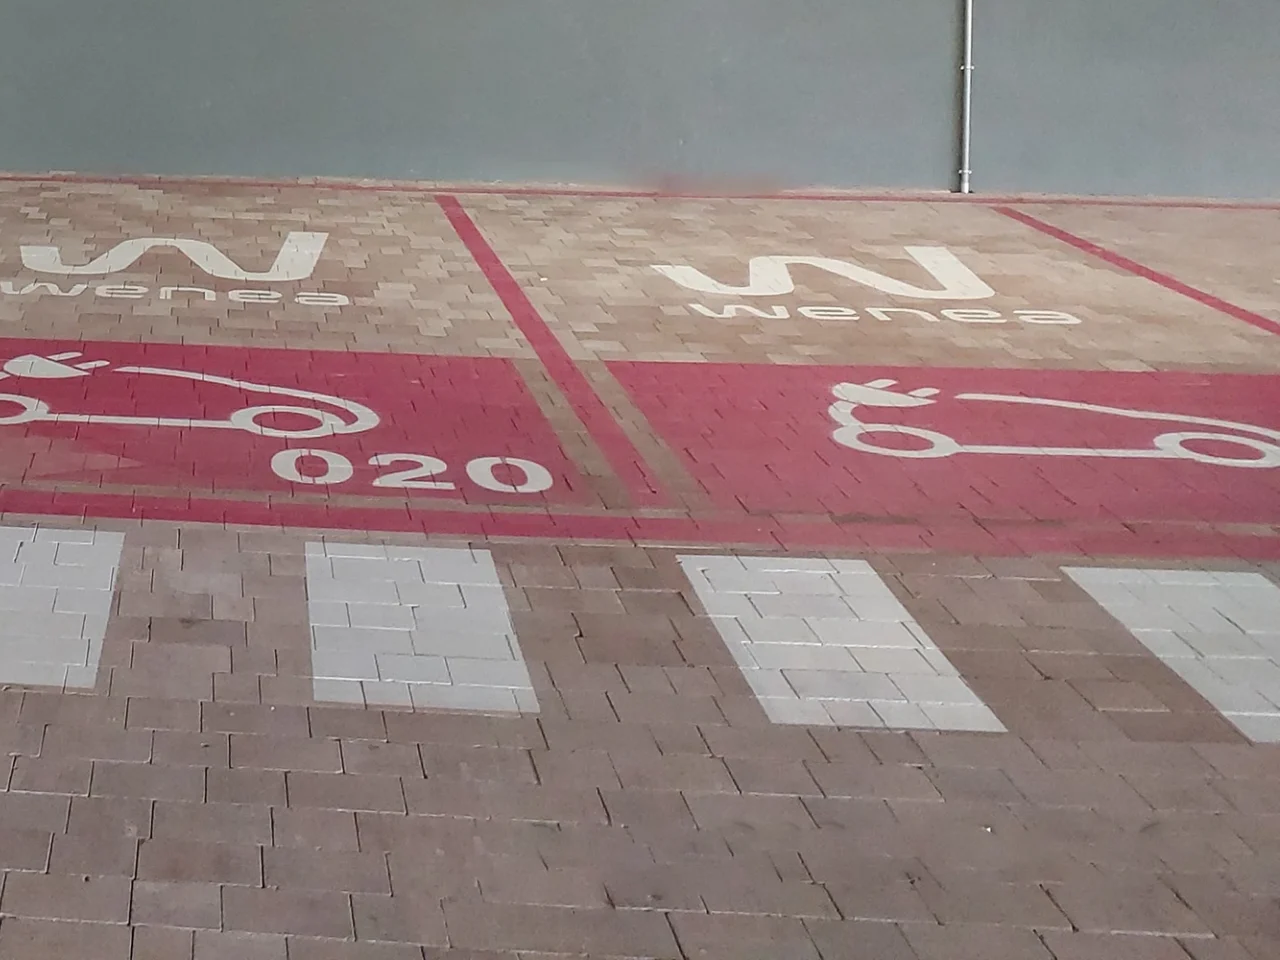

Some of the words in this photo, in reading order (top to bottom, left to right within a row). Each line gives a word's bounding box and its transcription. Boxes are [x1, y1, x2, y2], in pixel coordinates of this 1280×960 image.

[0, 280, 349, 305] wenea
[690, 303, 1081, 325] wenea
[270, 448, 553, 493] 020
